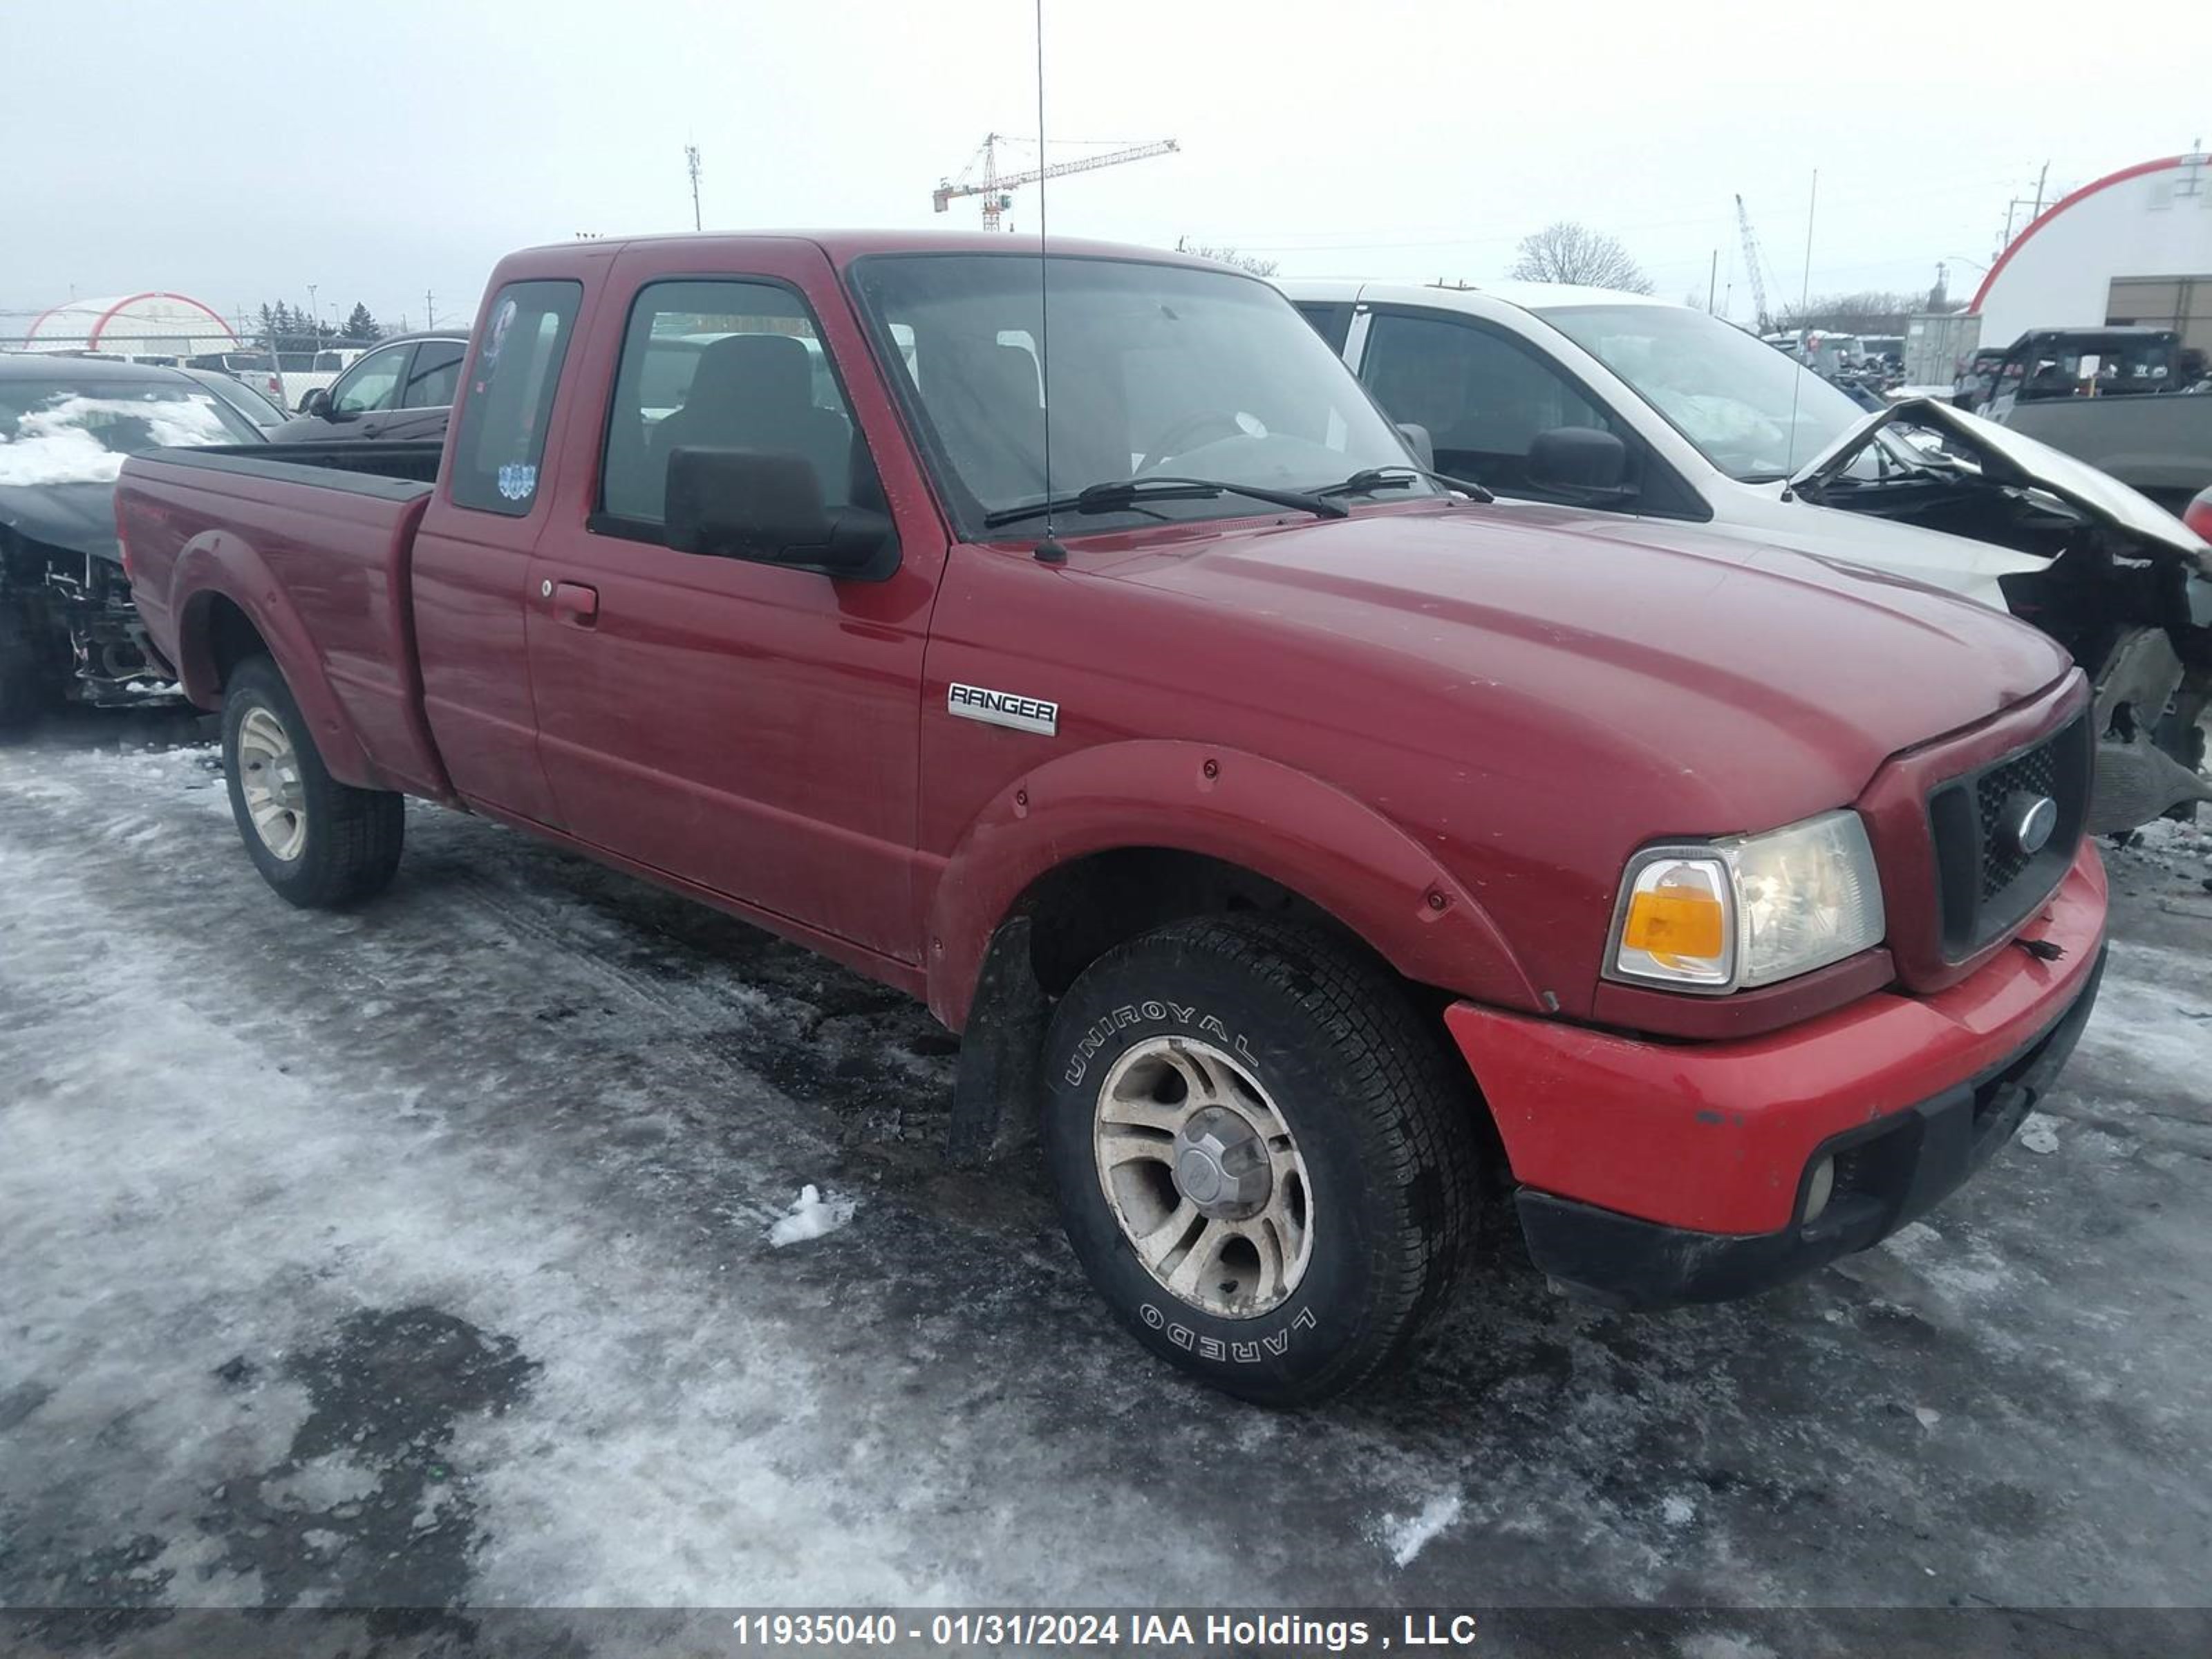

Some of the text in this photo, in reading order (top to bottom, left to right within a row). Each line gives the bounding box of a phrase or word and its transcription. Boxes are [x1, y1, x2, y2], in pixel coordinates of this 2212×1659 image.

[950, 685, 1055, 721] RANGER
[1065, 1000, 1259, 1087] UNIROYAL
[1139, 1302, 1317, 1362] LAREDO
